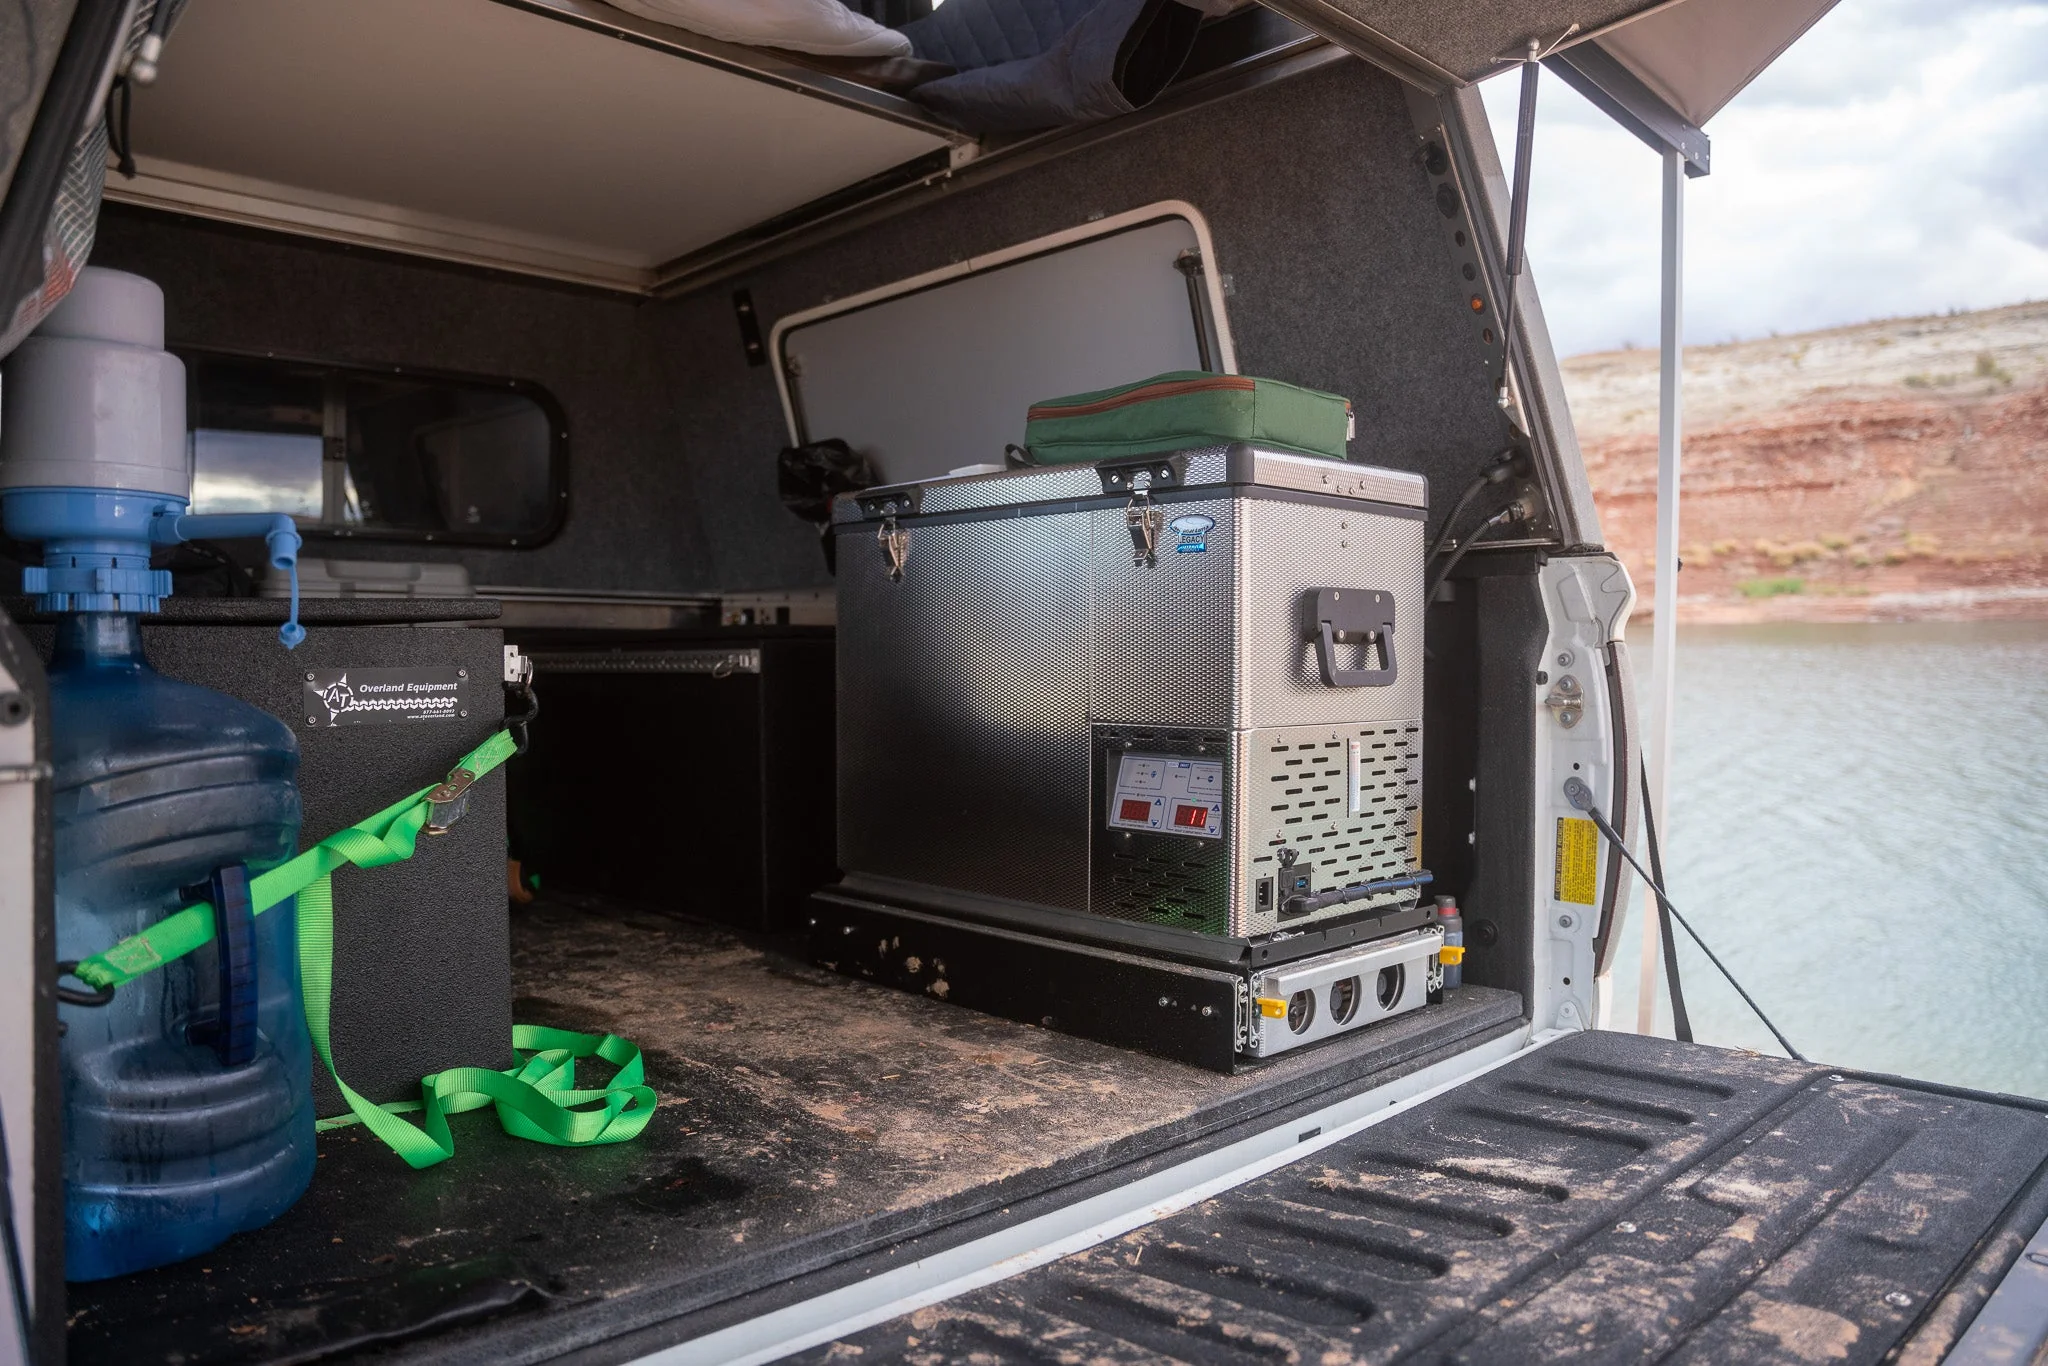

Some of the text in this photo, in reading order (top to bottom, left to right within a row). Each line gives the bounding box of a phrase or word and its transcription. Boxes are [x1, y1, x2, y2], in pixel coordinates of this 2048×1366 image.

[359, 682, 458, 694] Overland Equipment
[328, 688, 350, 708] AT
[1190, 809, 1207, 826] 11
